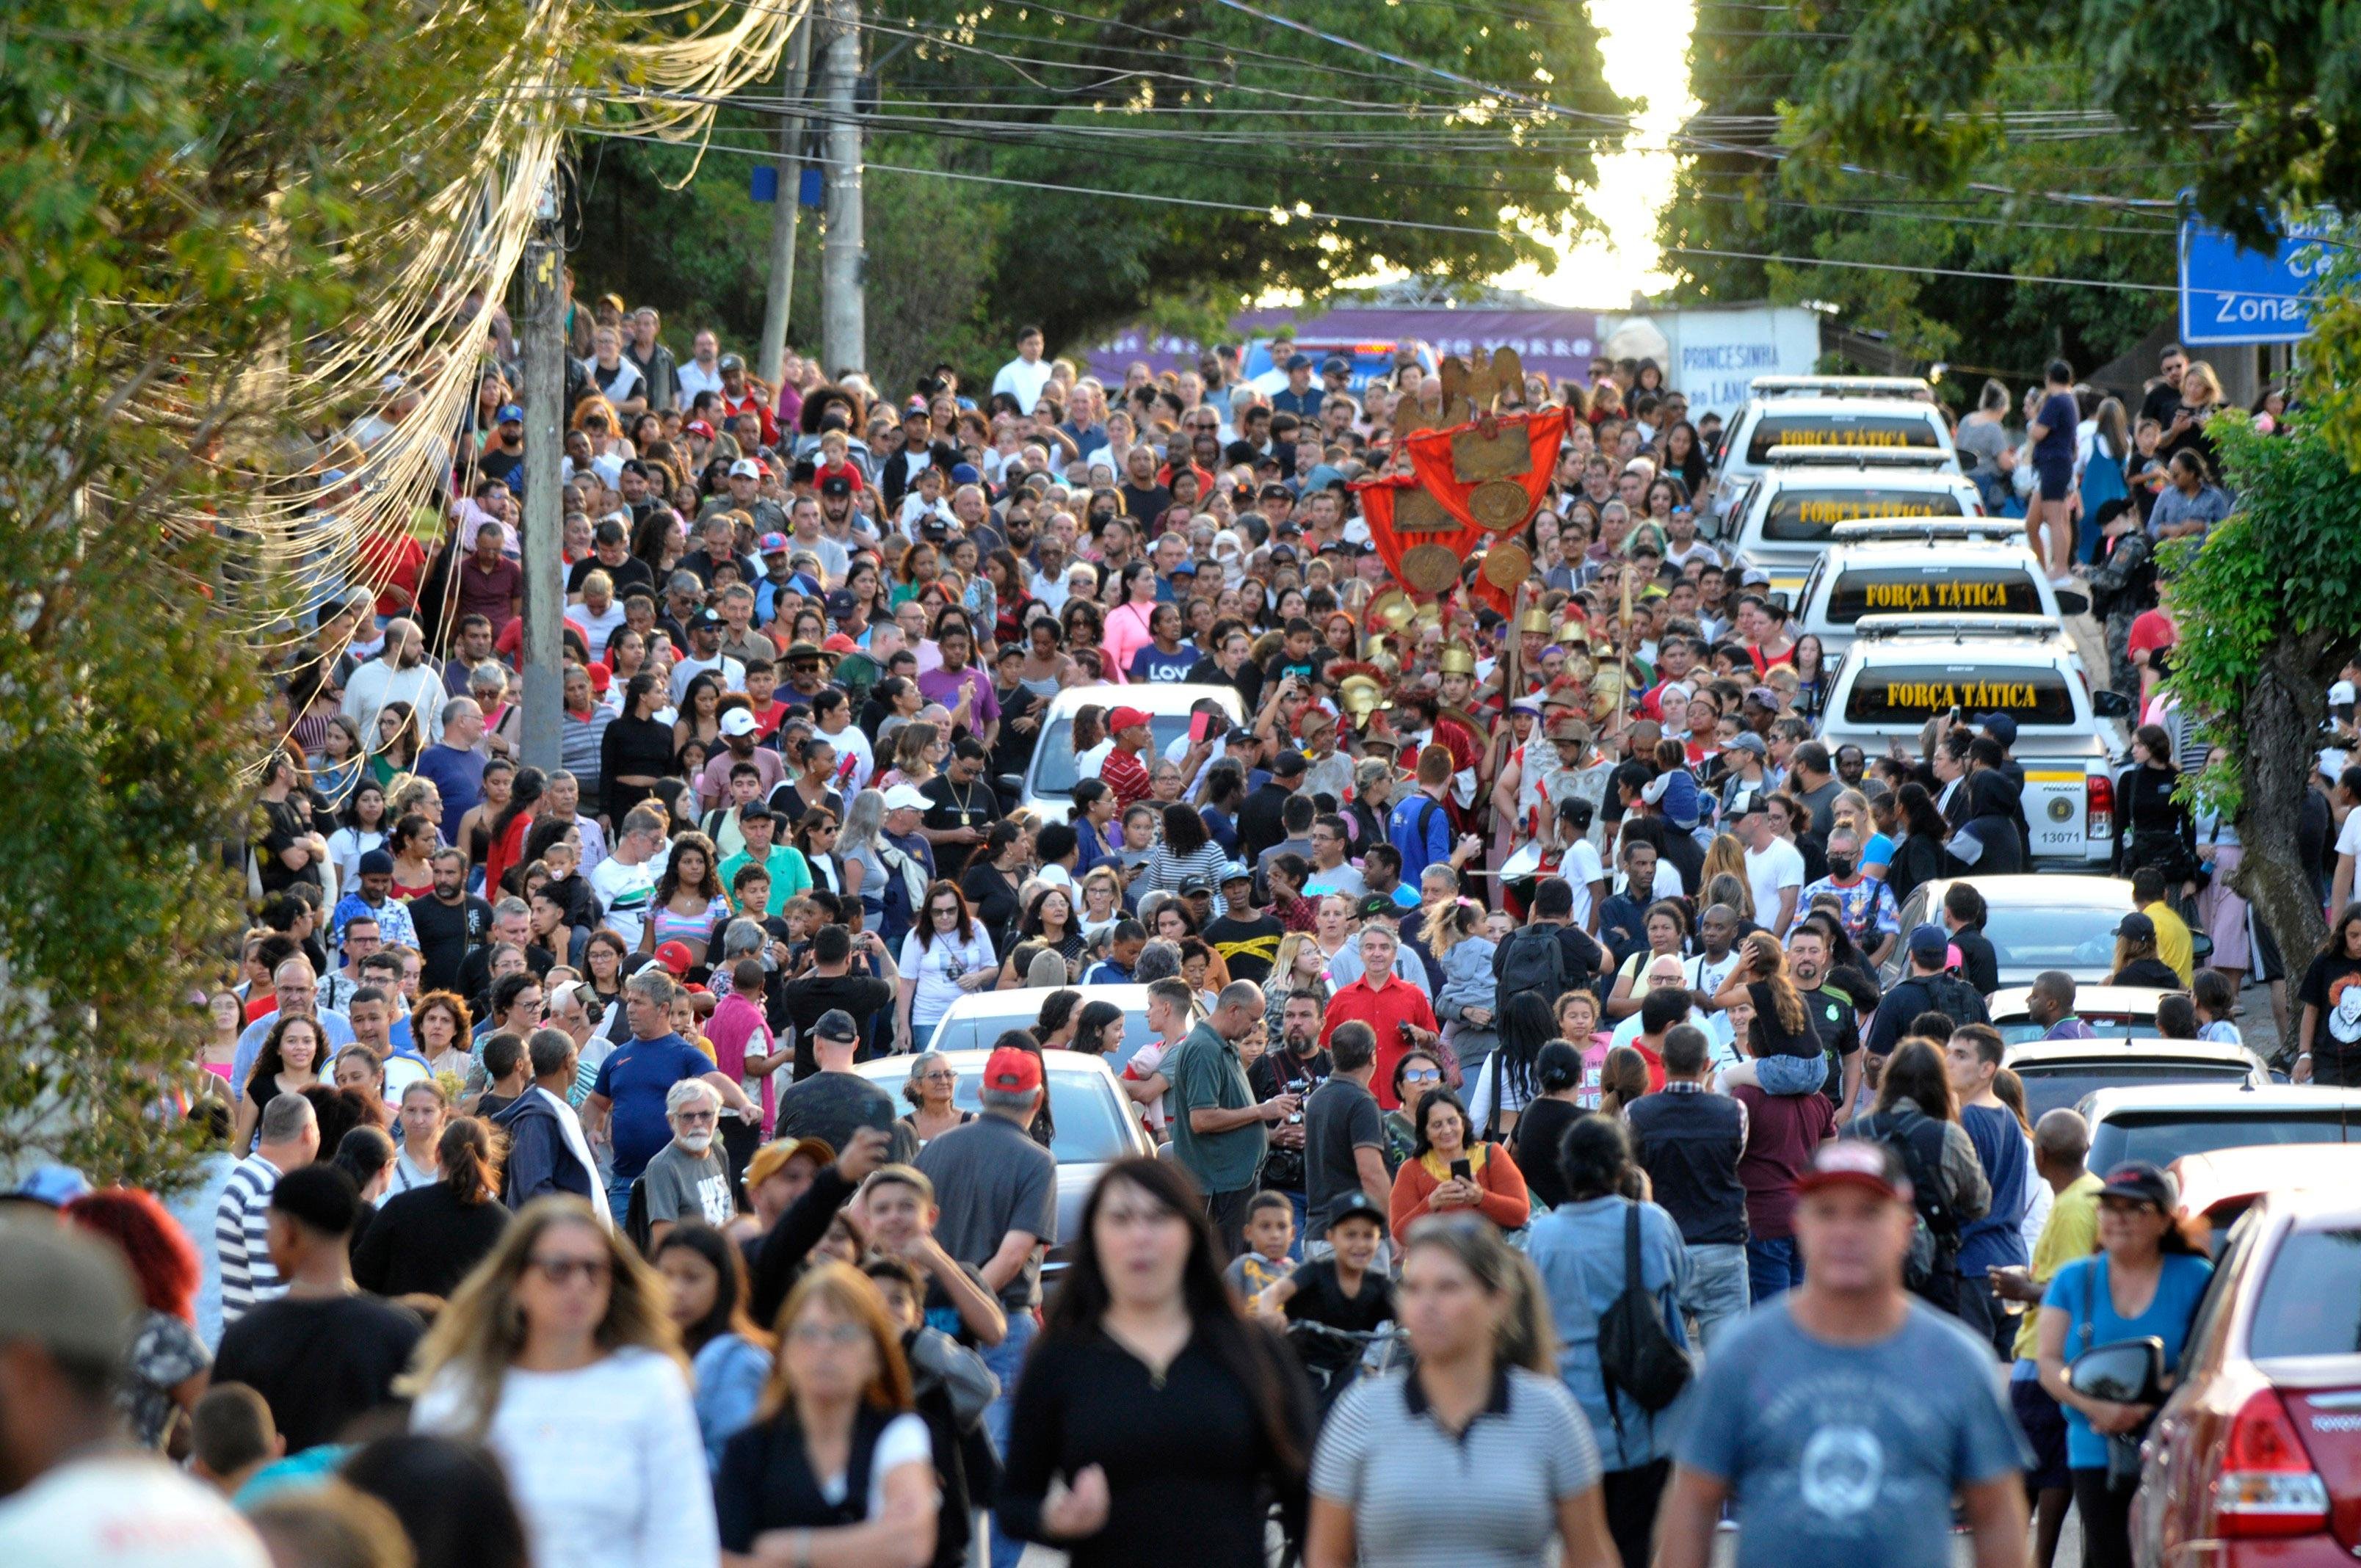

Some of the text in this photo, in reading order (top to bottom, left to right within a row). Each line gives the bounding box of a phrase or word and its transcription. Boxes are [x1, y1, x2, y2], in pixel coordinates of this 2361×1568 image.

[2216, 294, 2299, 323] Zona
[1865, 578, 2008, 611] FORÇA TÁTICA
[1887, 679, 2037, 713] FORÇA TÁTICA
[2041, 832, 2080, 843] 13071
[2309, 1415, 2361, 1433] TOYOT
